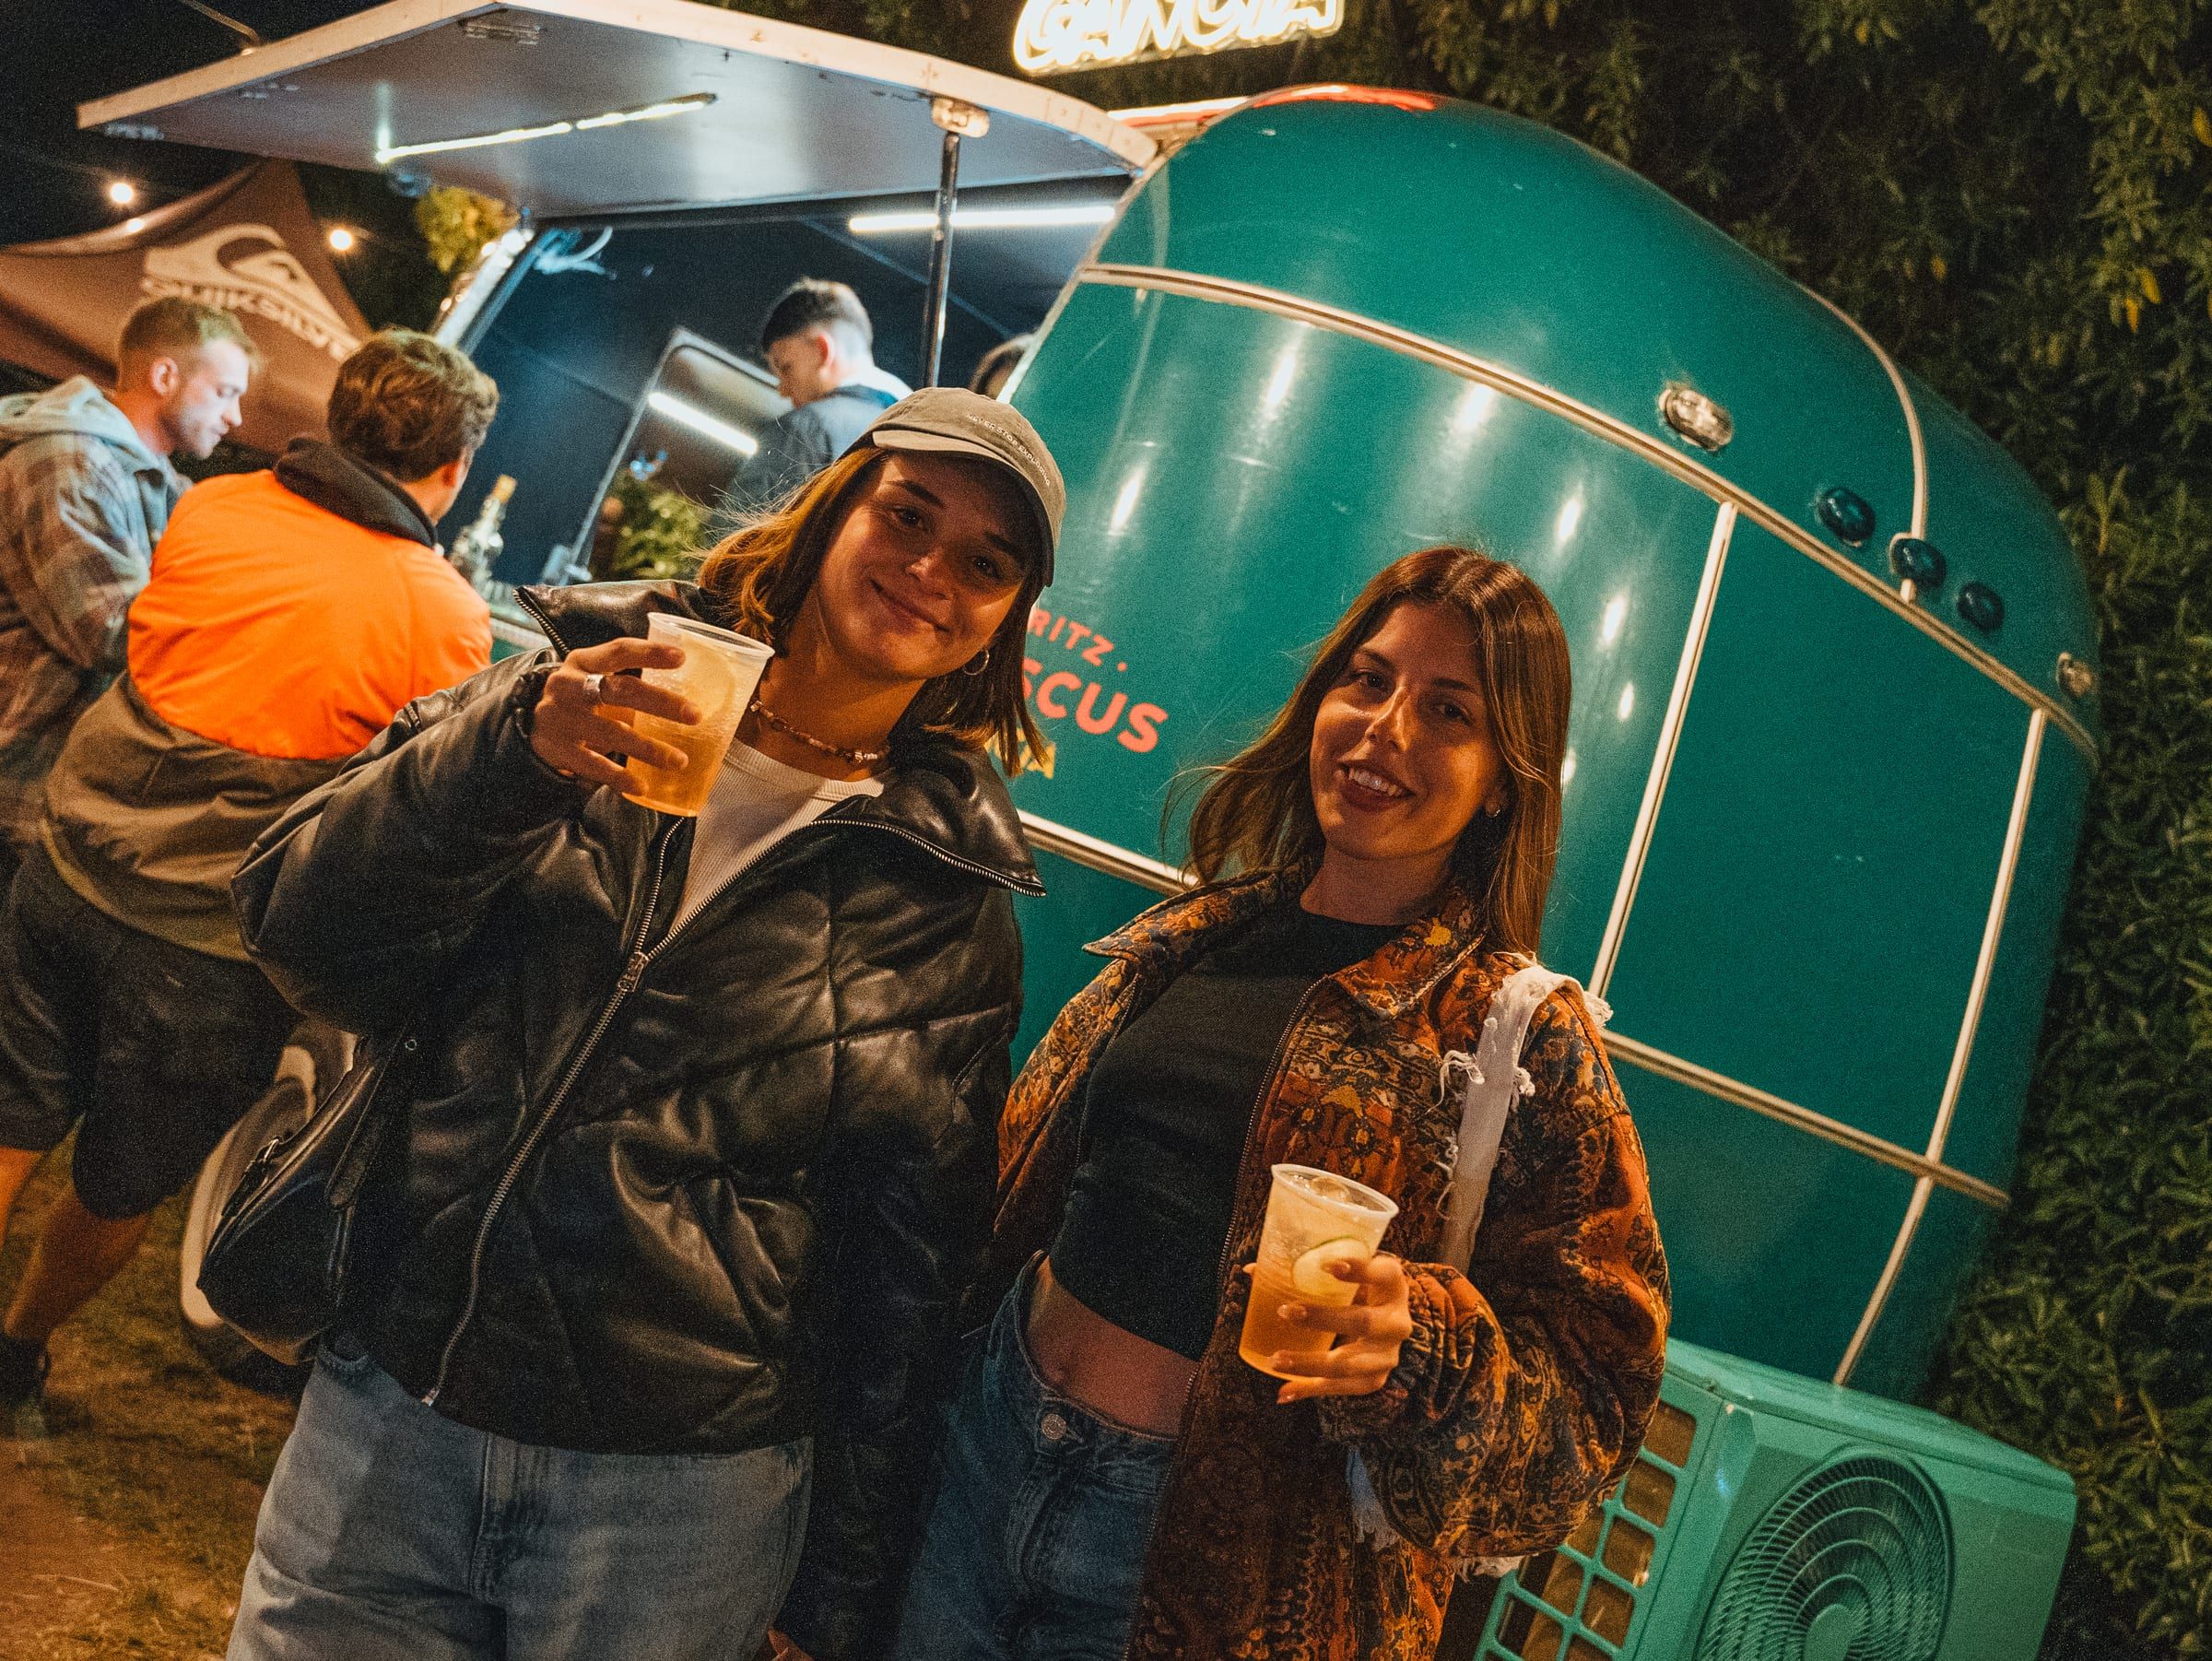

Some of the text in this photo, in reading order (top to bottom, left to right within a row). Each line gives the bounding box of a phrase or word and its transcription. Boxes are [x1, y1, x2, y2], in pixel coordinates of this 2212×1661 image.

[966, 414, 1051, 488] NEVER STOP EXPLORING
[1028, 608, 1114, 666] RITZ
